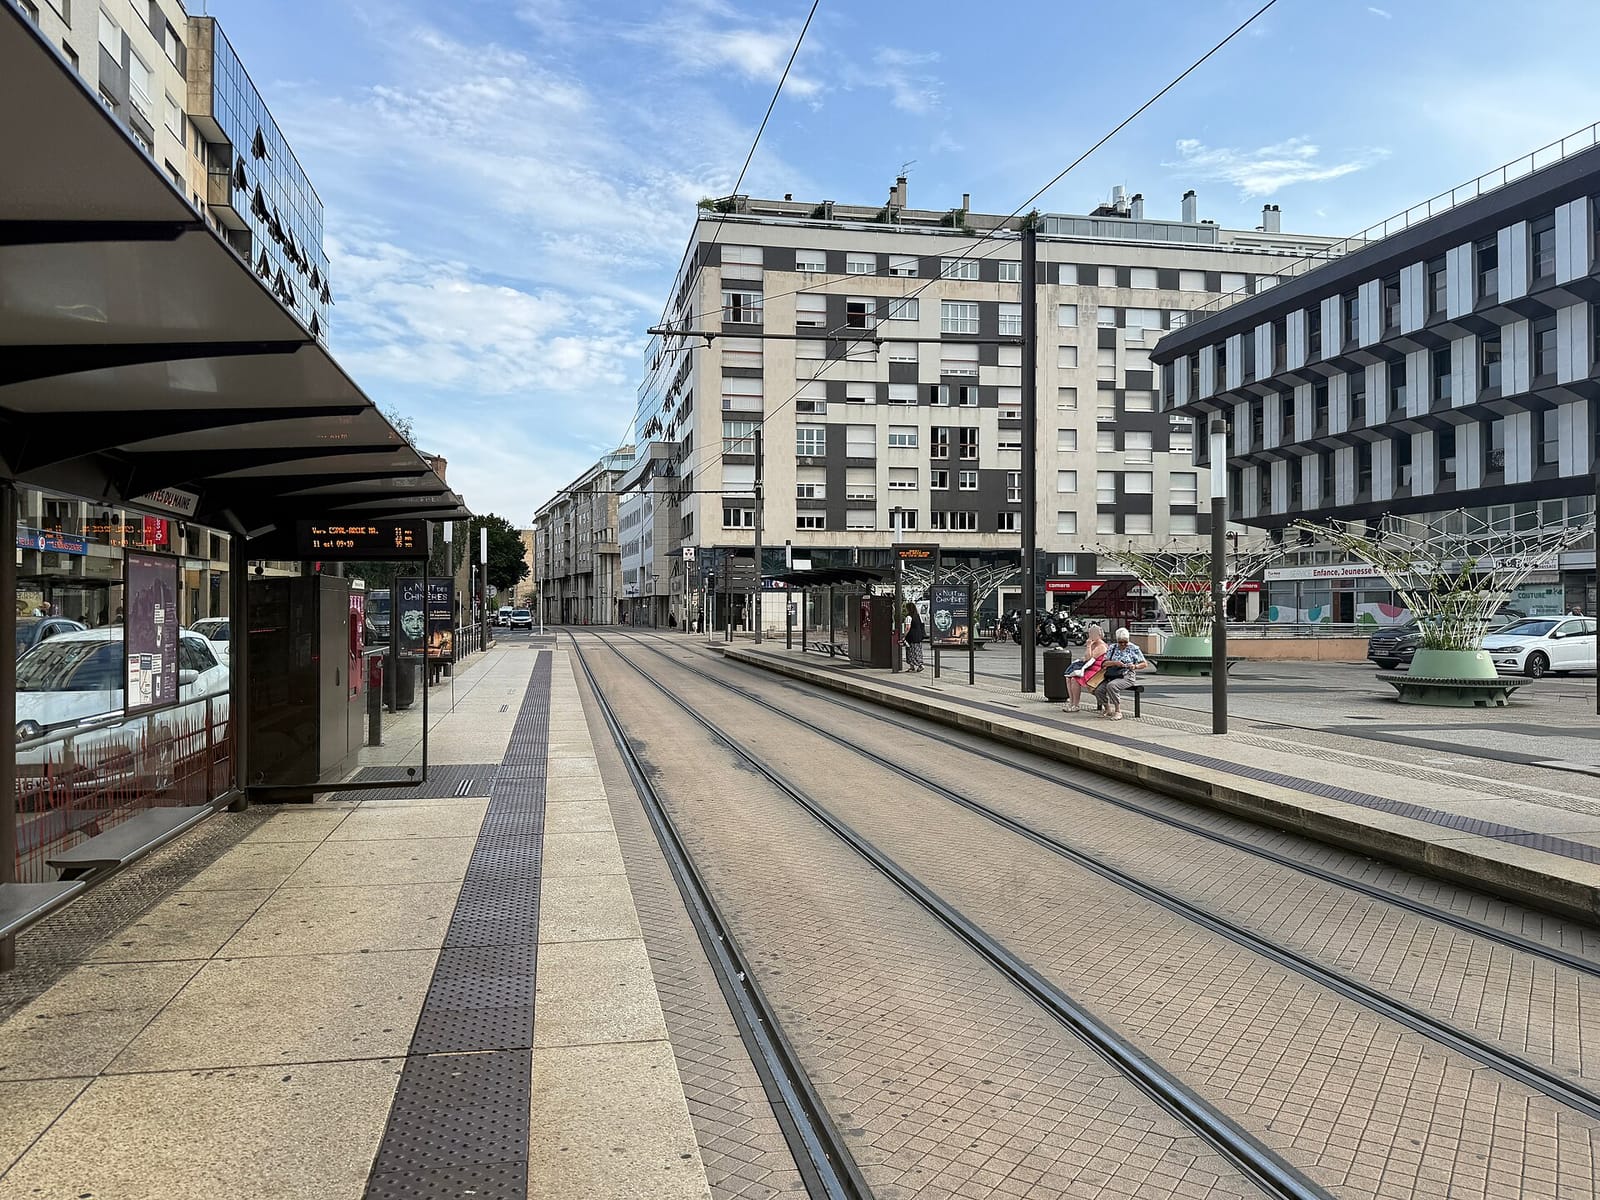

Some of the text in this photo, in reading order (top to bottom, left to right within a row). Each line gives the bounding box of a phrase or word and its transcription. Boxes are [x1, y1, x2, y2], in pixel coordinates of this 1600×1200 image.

[312, 526, 327, 535] Vers
[1313, 568, 1340, 577] Enfance,
[1341, 567, 1373, 575] Jeunesse
[414, 582, 436, 592] NIT
